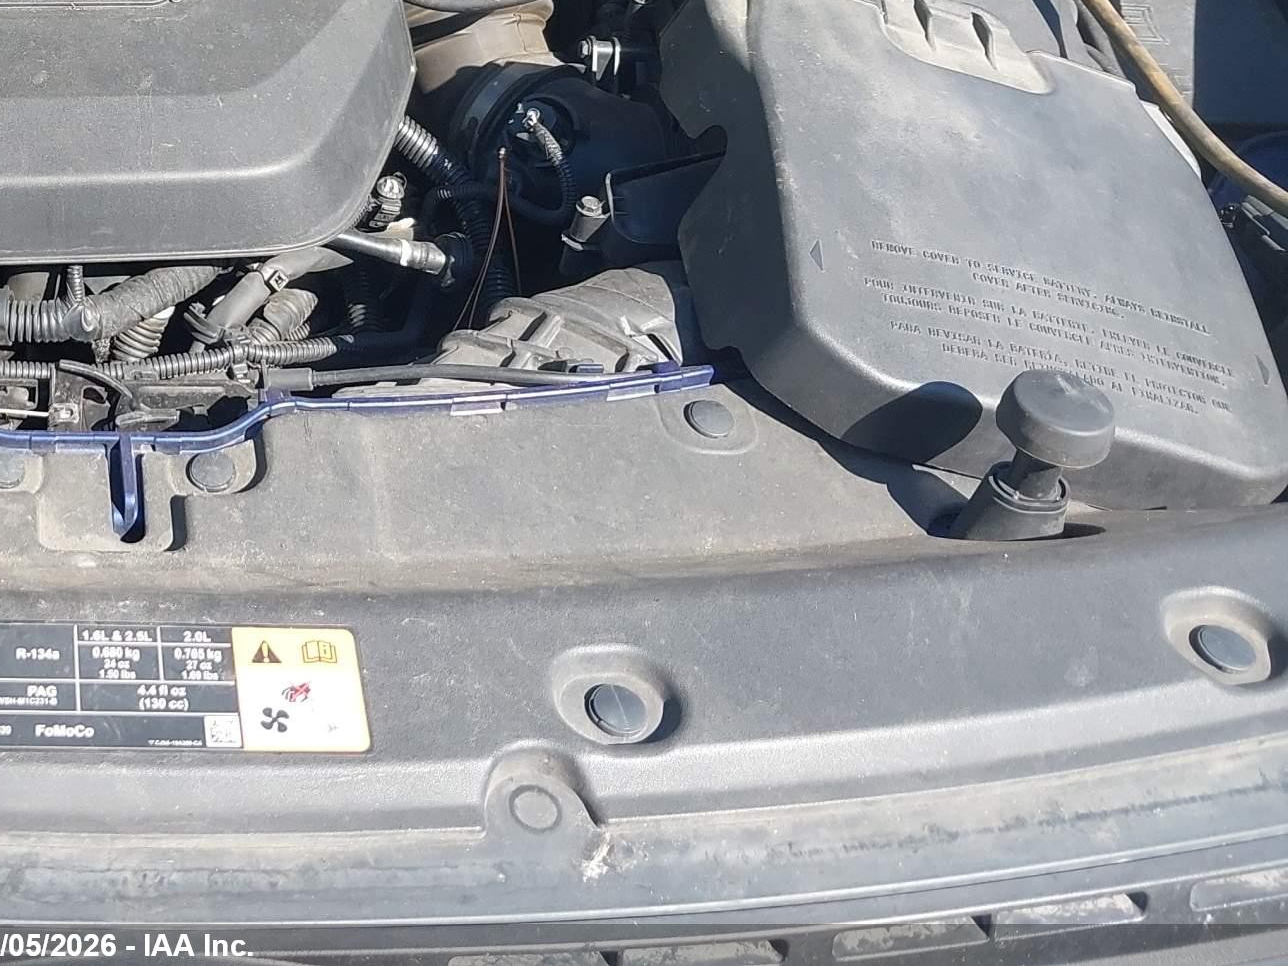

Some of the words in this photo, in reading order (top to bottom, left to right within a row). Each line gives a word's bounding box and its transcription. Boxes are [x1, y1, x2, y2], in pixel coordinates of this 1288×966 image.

[871, 239, 915, 256] REMOVE
[922, 249, 960, 265] COVER
[965, 258, 982, 269] TO
[987, 263, 1037, 283] SERVICE
[972, 272, 1010, 289] COVER
[1016, 282, 1052, 299] AFTER
[982, 298, 1006, 313] SUR
[1011, 305, 1028, 317] LA
[890, 319, 922, 335] PARA
[112, 630, 123, 642] &
[183, 630, 212, 643] 2.0L
[15, 647, 60, 660] R-134a
[124, 646, 140, 662] kg
[206, 648, 222, 663] kg
[104, 658, 117, 669] 24
[117, 660, 130, 669] oz
[186, 660, 198, 670] 27
[199, 662, 212, 671] oz
[120, 669, 137, 680] lbs
[202, 671, 219, 681] lbs
[27, 685, 58, 697] PAG
[137, 684, 158, 696] 4.4
[158, 685, 168, 696] fl
[170, 687, 187, 696] oz
[138, 697, 167, 710] (130
[168, 698, 189, 711] cc)
[35, 724, 95, 738] FoMoCo
